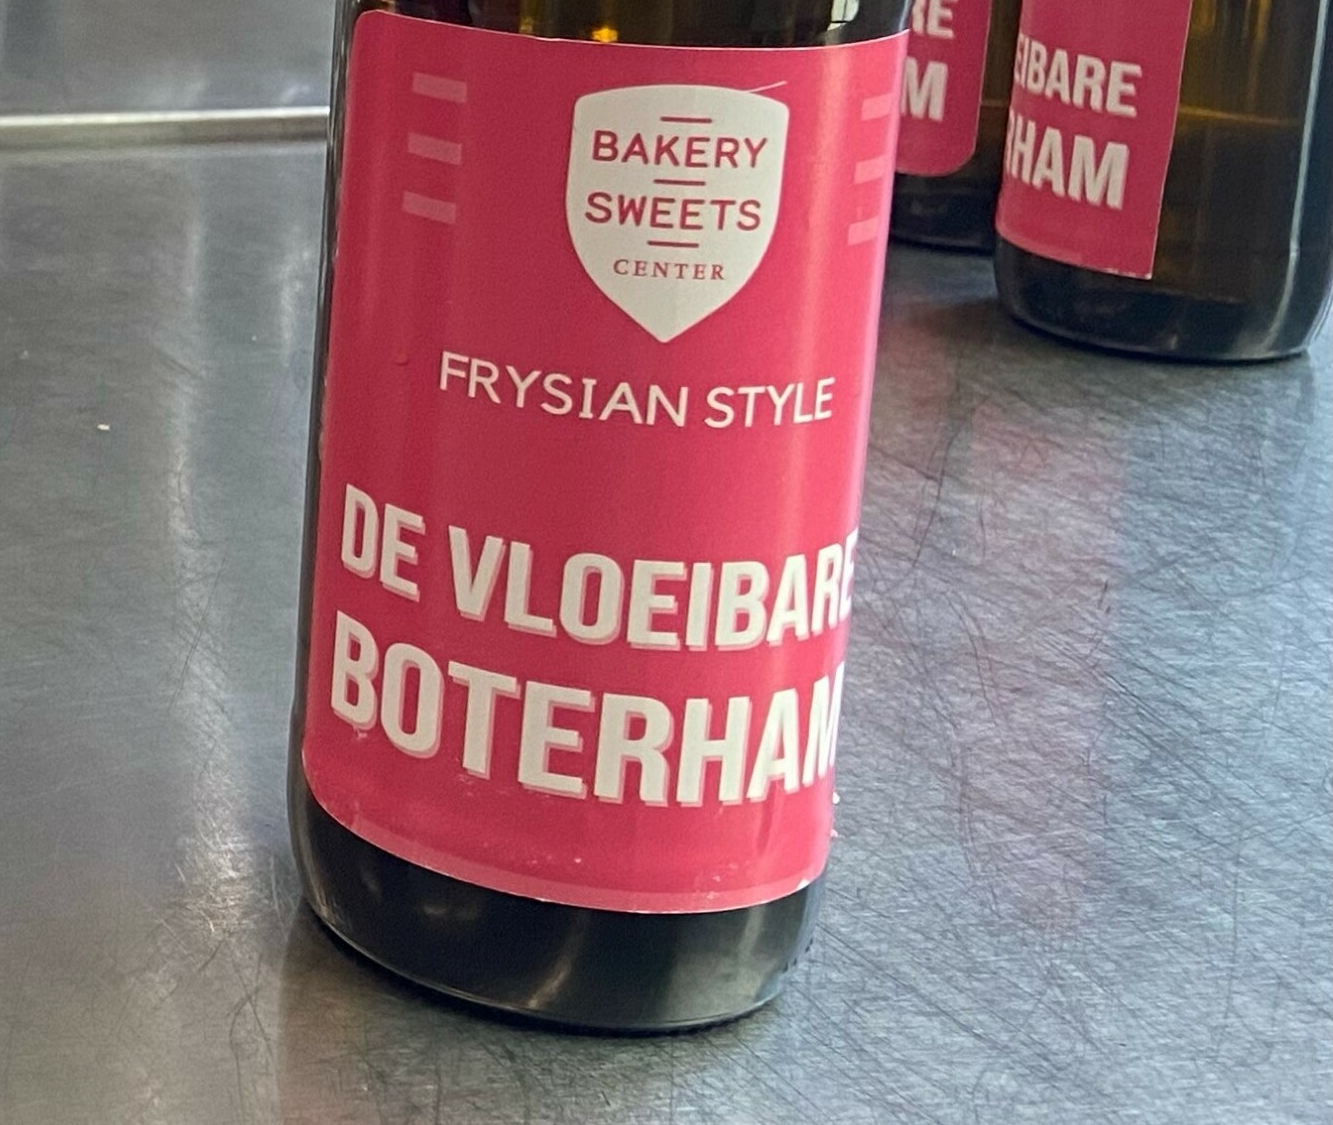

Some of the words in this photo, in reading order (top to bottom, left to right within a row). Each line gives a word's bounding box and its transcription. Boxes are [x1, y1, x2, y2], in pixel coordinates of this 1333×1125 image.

[591, 129, 768, 169] BAKERY
[584, 191, 762, 232] SWEETS
[613, 258, 725, 281] CENTER
[439, 350, 689, 428] FRYSIAN
[703, 376, 836, 429] STYLE
[341, 482, 426, 603] DE
[448, 527, 859, 652] VLOEIBARE
[331, 610, 845, 808] BOTERHAM
